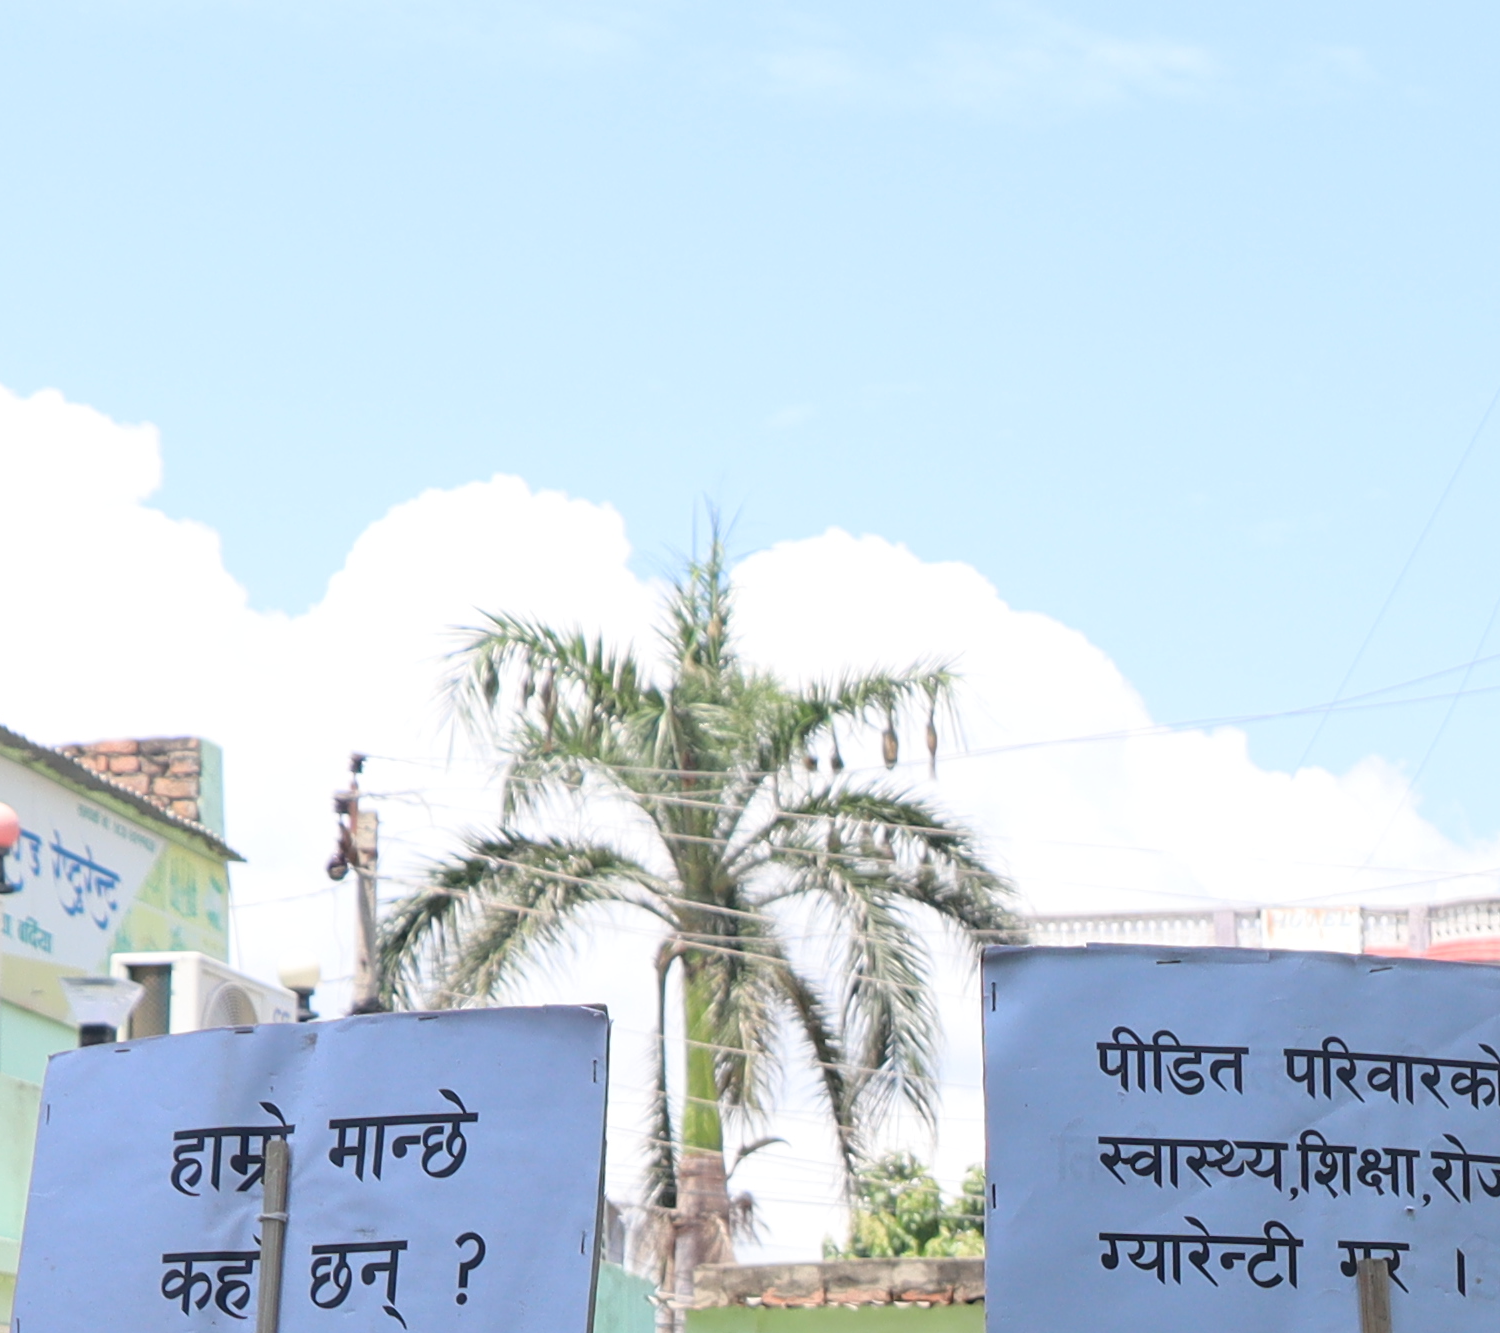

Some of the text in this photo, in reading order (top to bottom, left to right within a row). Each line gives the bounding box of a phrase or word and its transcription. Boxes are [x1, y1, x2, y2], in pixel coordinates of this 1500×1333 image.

[1096, 1026, 1249, 1096] पीडित
[328, 1088, 479, 1181] मान्छे
[161, 1231, 486, 1329] कह छन् ?
[1099, 1216, 1304, 1291] ग्यारेन्टी
[1338, 1240, 1410, 1294] गर
